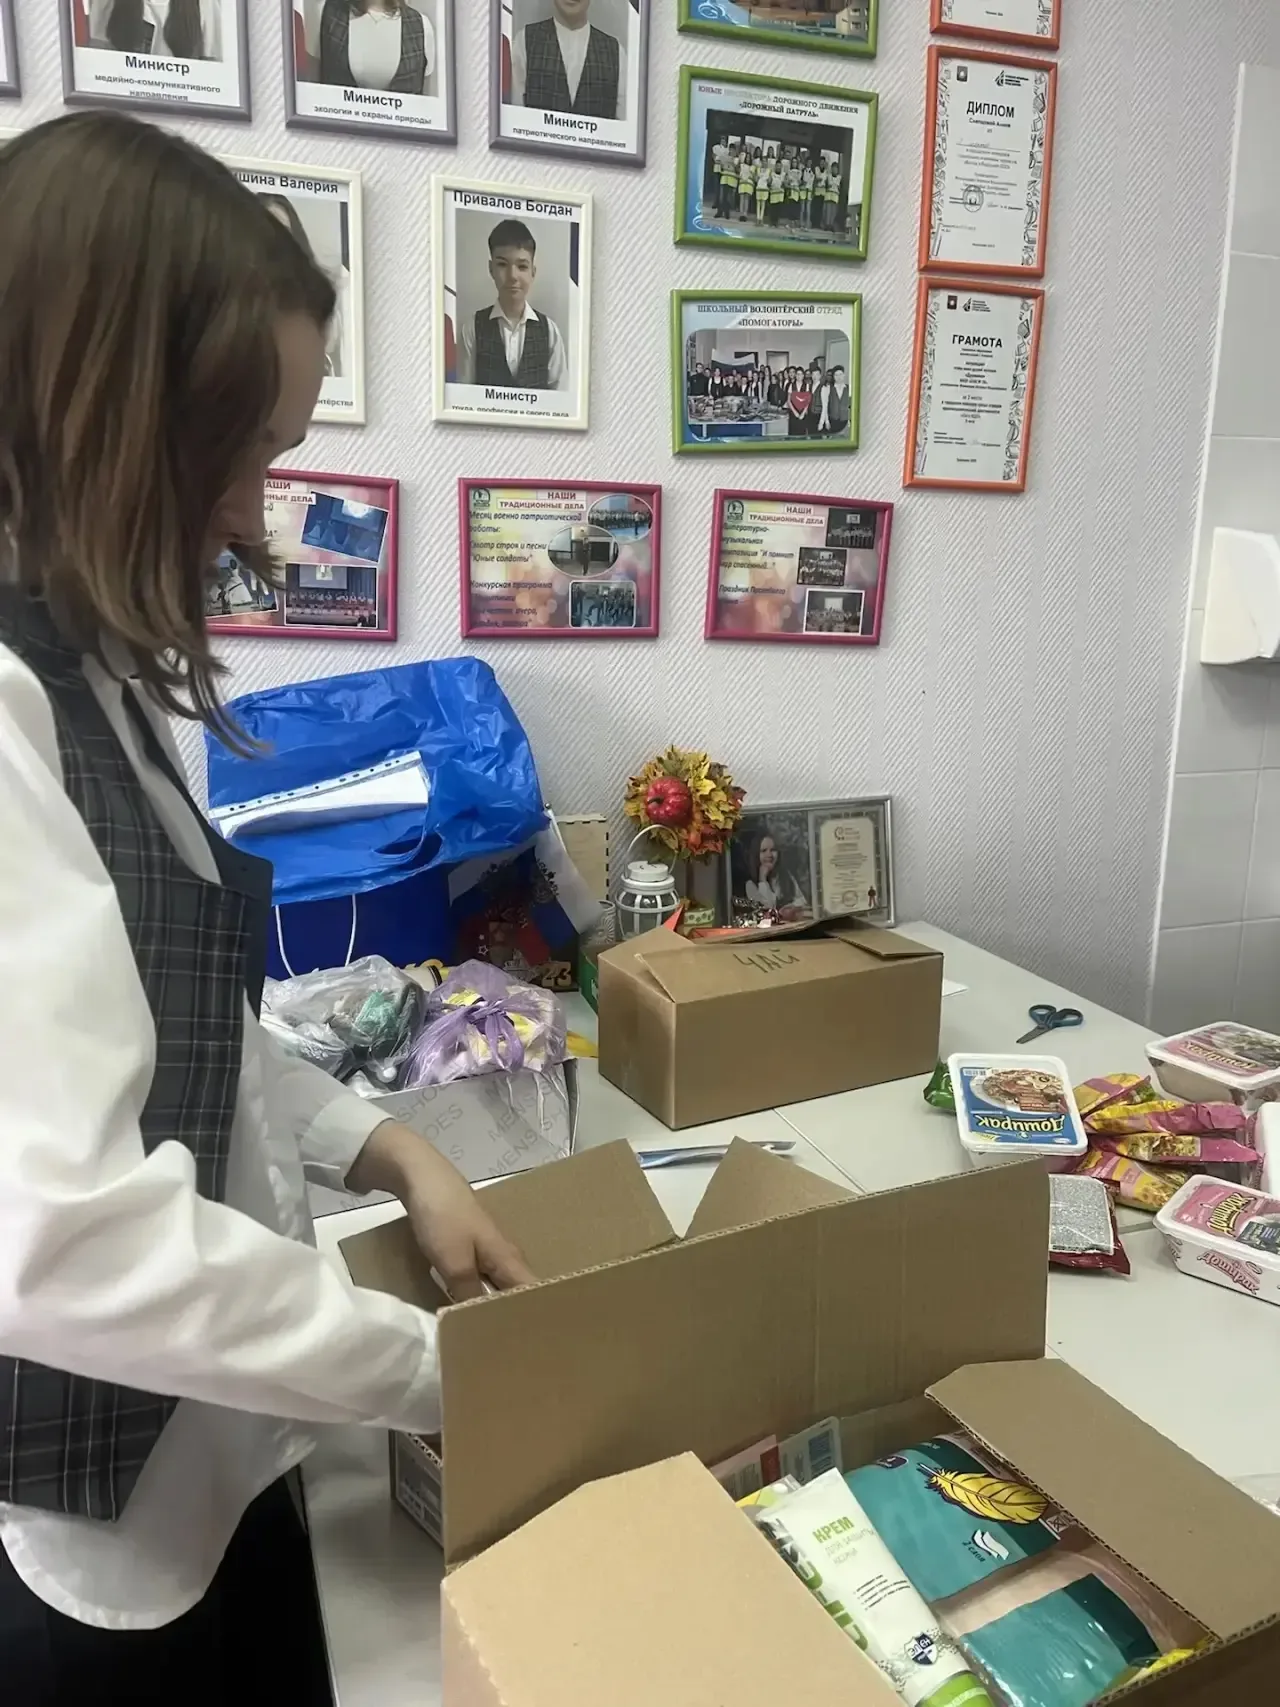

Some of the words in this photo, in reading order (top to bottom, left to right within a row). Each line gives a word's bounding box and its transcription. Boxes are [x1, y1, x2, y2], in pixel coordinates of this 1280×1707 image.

[125, 56, 190, 76] Министр
[343, 89, 403, 110] Министр
[773, 96, 818, 108] ДОРОЖНОГО
[314, 105, 352, 116] экологии
[361, 111, 393, 121] охраны
[395, 115, 432, 125] природы
[966, 101, 1015, 118] ДИПЛОМ
[543, 113, 598, 133] Министр
[512, 127, 577, 142] патриотического
[578, 137, 626, 149] направления
[234, 171, 275, 186] шина
[280, 175, 338, 194] Валерия
[453, 189, 522, 210] Привалов
[526, 199, 573, 216] Богдан
[697, 304, 748, 313] ШКОЛЬНЫЙ
[750, 304, 815, 314] ВОЛОНТЁРСКИЙ
[816, 306, 843, 315] ОТРЯД
[952, 334, 1003, 348] ГРАМОТА
[317, 398, 354, 407] нтёрства
[484, 387, 538, 404] Министр
[265, 480, 291, 490] АШИ
[291, 495, 313, 503] ДЕЛА
[547, 491, 576, 500] НАШИ
[499, 501, 561, 509] ТРАДИЦИОННЫЕ
[564, 502, 584, 510] ДЕЛА
[786, 505, 812, 515] НАШИ
[493, 512, 519, 520] военно
[520, 512, 582, 522] патриотической
[749, 514, 805, 524] ТРАДИЦИОННЫЕ
[805, 517, 824, 525] ДЕЛА
[541, 960, 572, 988] 23
[396, 1084, 449, 1124] SHO
[423, 1103, 464, 1142] OES
[974, 1113, 1066, 1133] Доширак
[488, 1129, 538, 1175] MENS
[812, 1516, 855, 1543] КРЕМ
